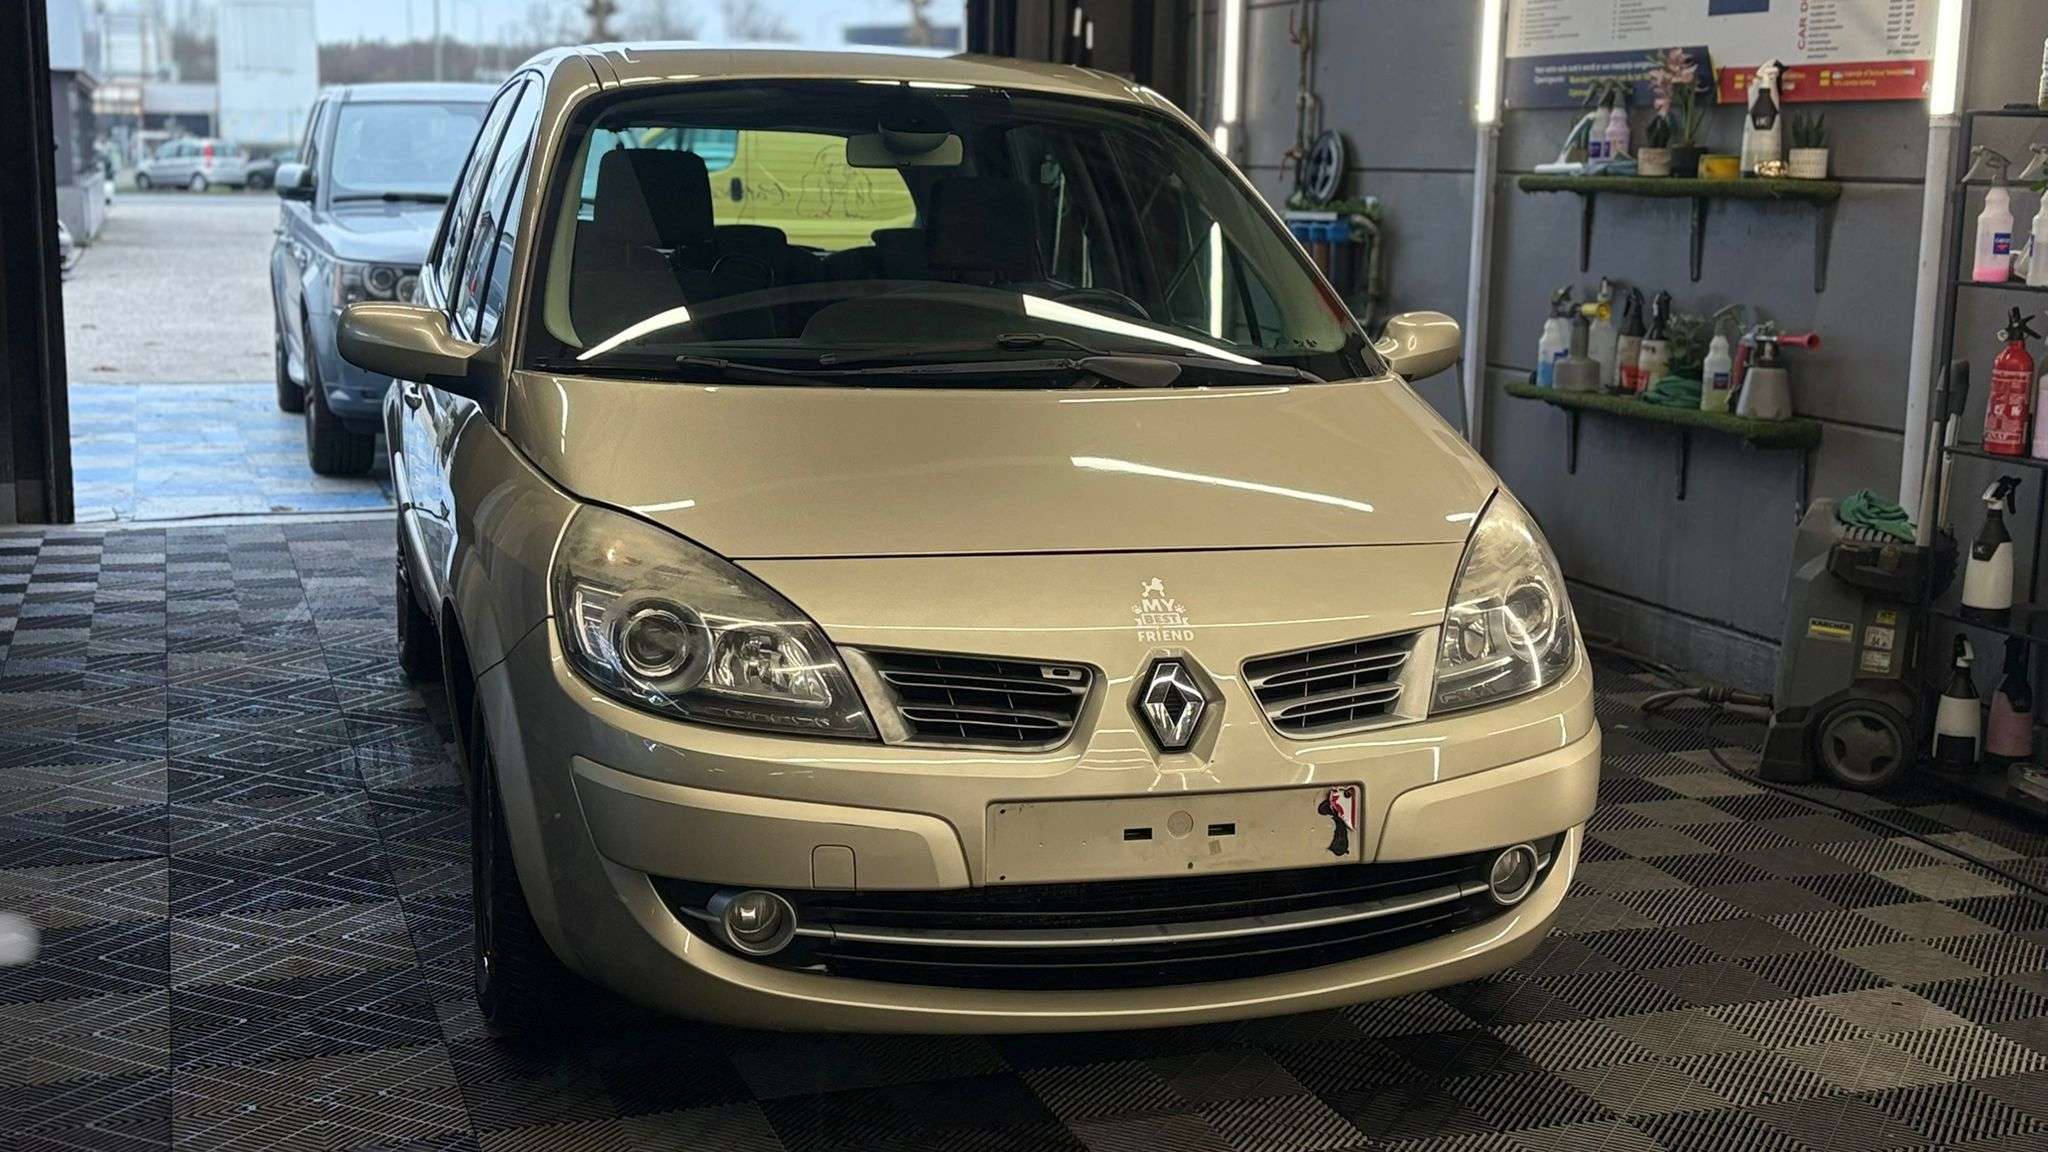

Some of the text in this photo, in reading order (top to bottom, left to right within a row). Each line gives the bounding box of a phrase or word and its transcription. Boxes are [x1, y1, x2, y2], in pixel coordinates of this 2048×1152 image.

[1797, 16, 1808, 50] CAR
[1141, 598, 1175, 612] MY
[1144, 614, 1178, 624] BEST
[1137, 630, 1194, 642] FRIEND
